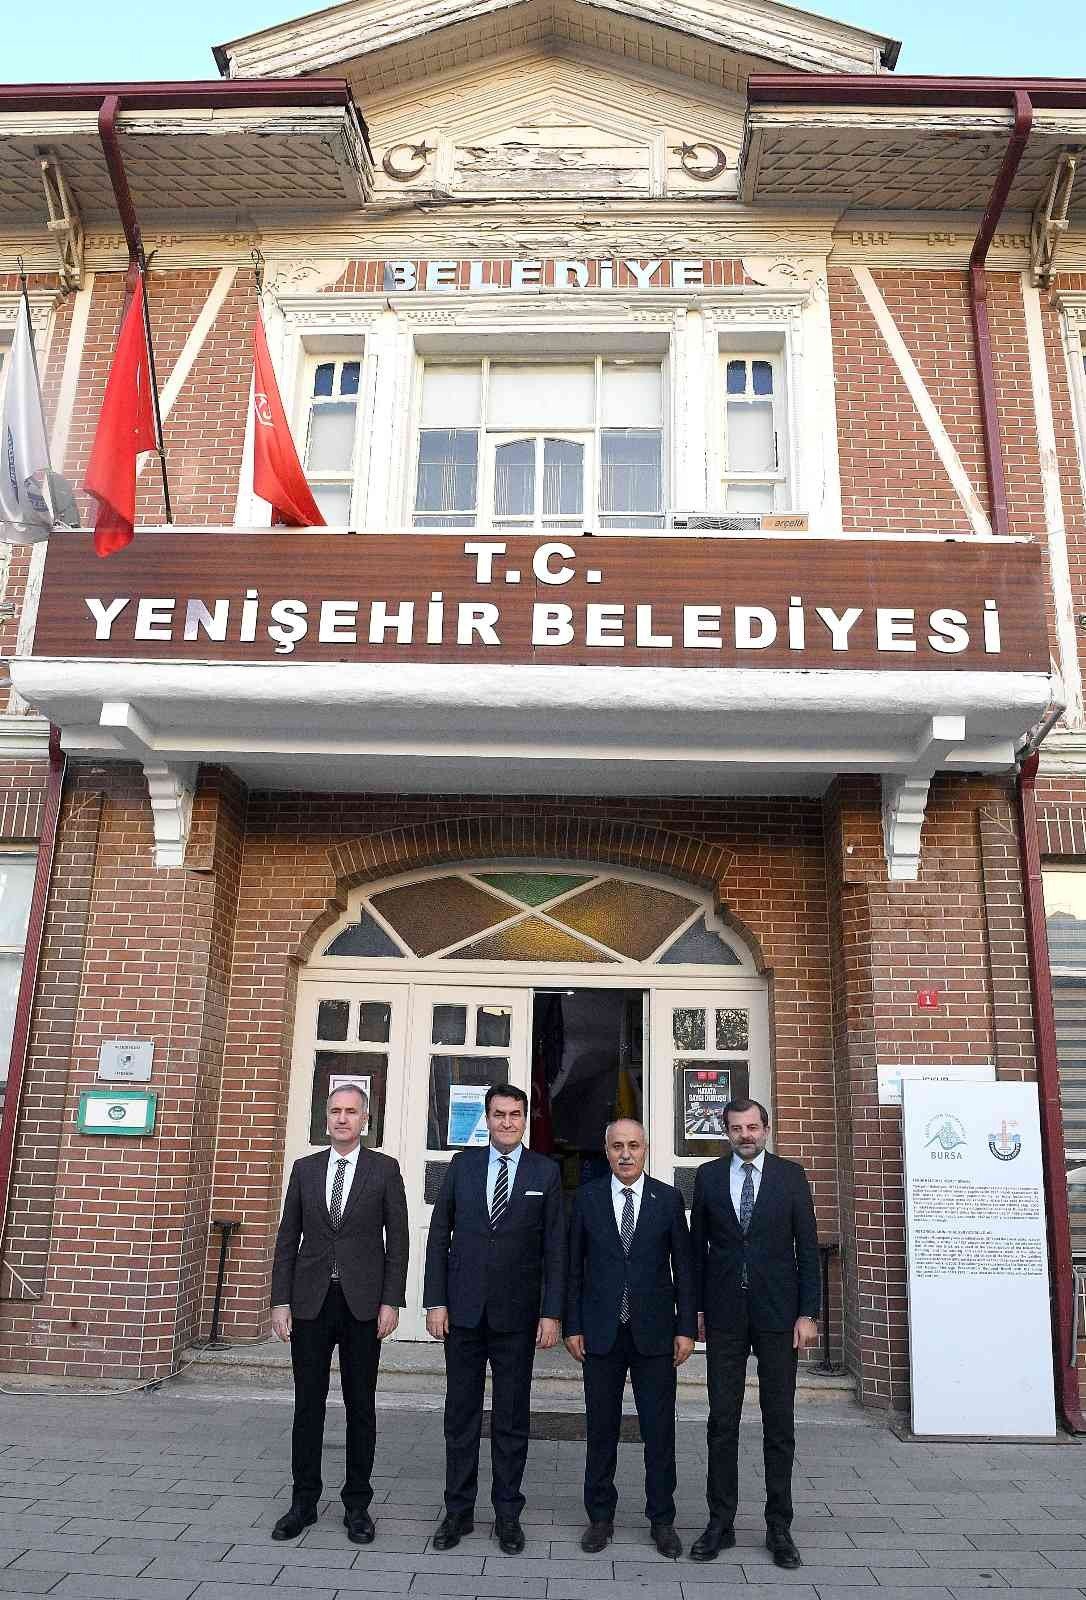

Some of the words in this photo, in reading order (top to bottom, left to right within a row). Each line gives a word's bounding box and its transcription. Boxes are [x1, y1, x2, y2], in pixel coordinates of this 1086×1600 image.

[384, 259, 704, 291] BELEDİYE
[464, 542, 602, 585] T.C.
[85, 589, 501, 654] YENİŞEHİR
[532, 596, 1001, 653] BELEDİYESİ
[931, 1151, 963, 1160] BURSA
